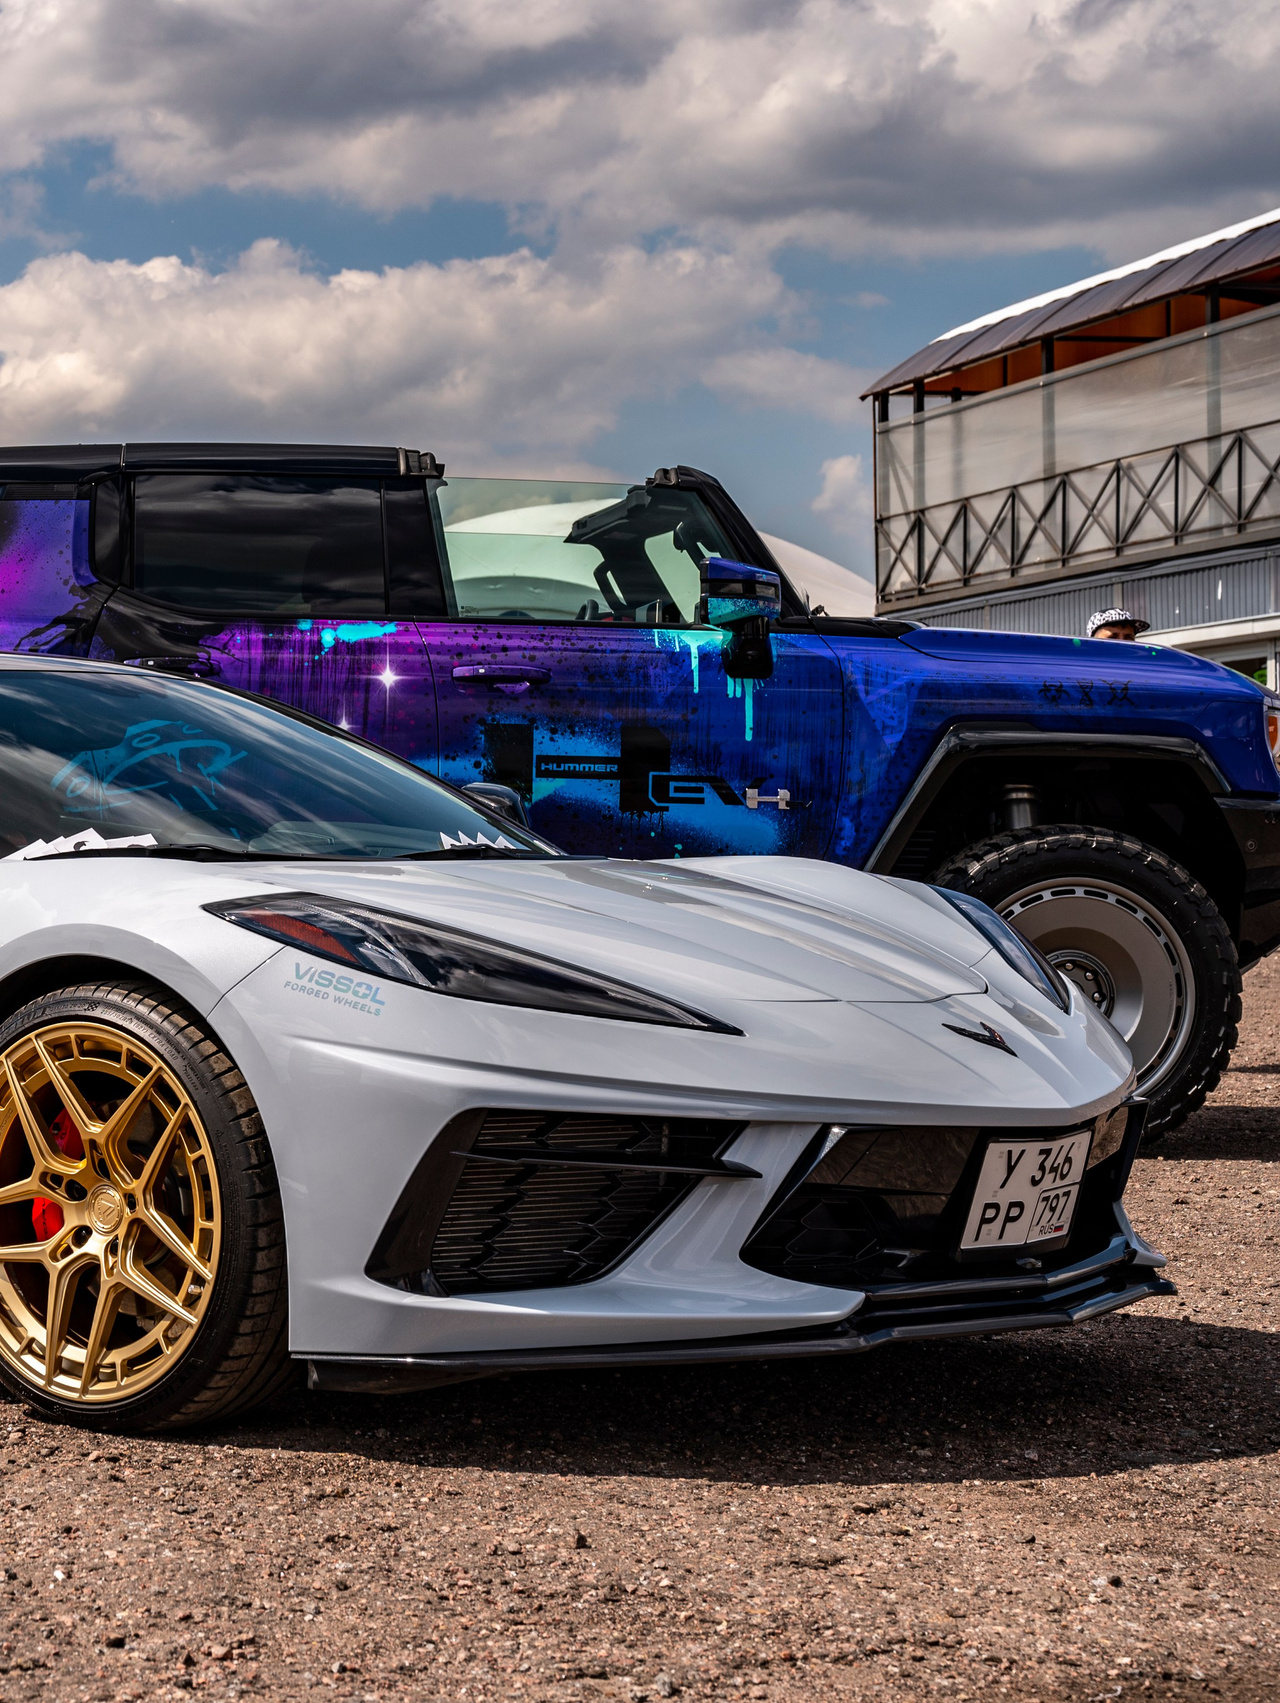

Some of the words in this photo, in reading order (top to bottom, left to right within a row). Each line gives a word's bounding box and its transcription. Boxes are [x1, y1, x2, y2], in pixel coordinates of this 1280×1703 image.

[540, 762, 619, 773] HUMMER
[283, 980, 330, 1000] FORGED
[333, 994, 382, 1017] WHEELS
[294, 962, 386, 1007] VISSOL
[1030, 1141, 1076, 1188] 346
[1035, 1189, 1072, 1227] 797
[1038, 1223, 1055, 1237] RUS
